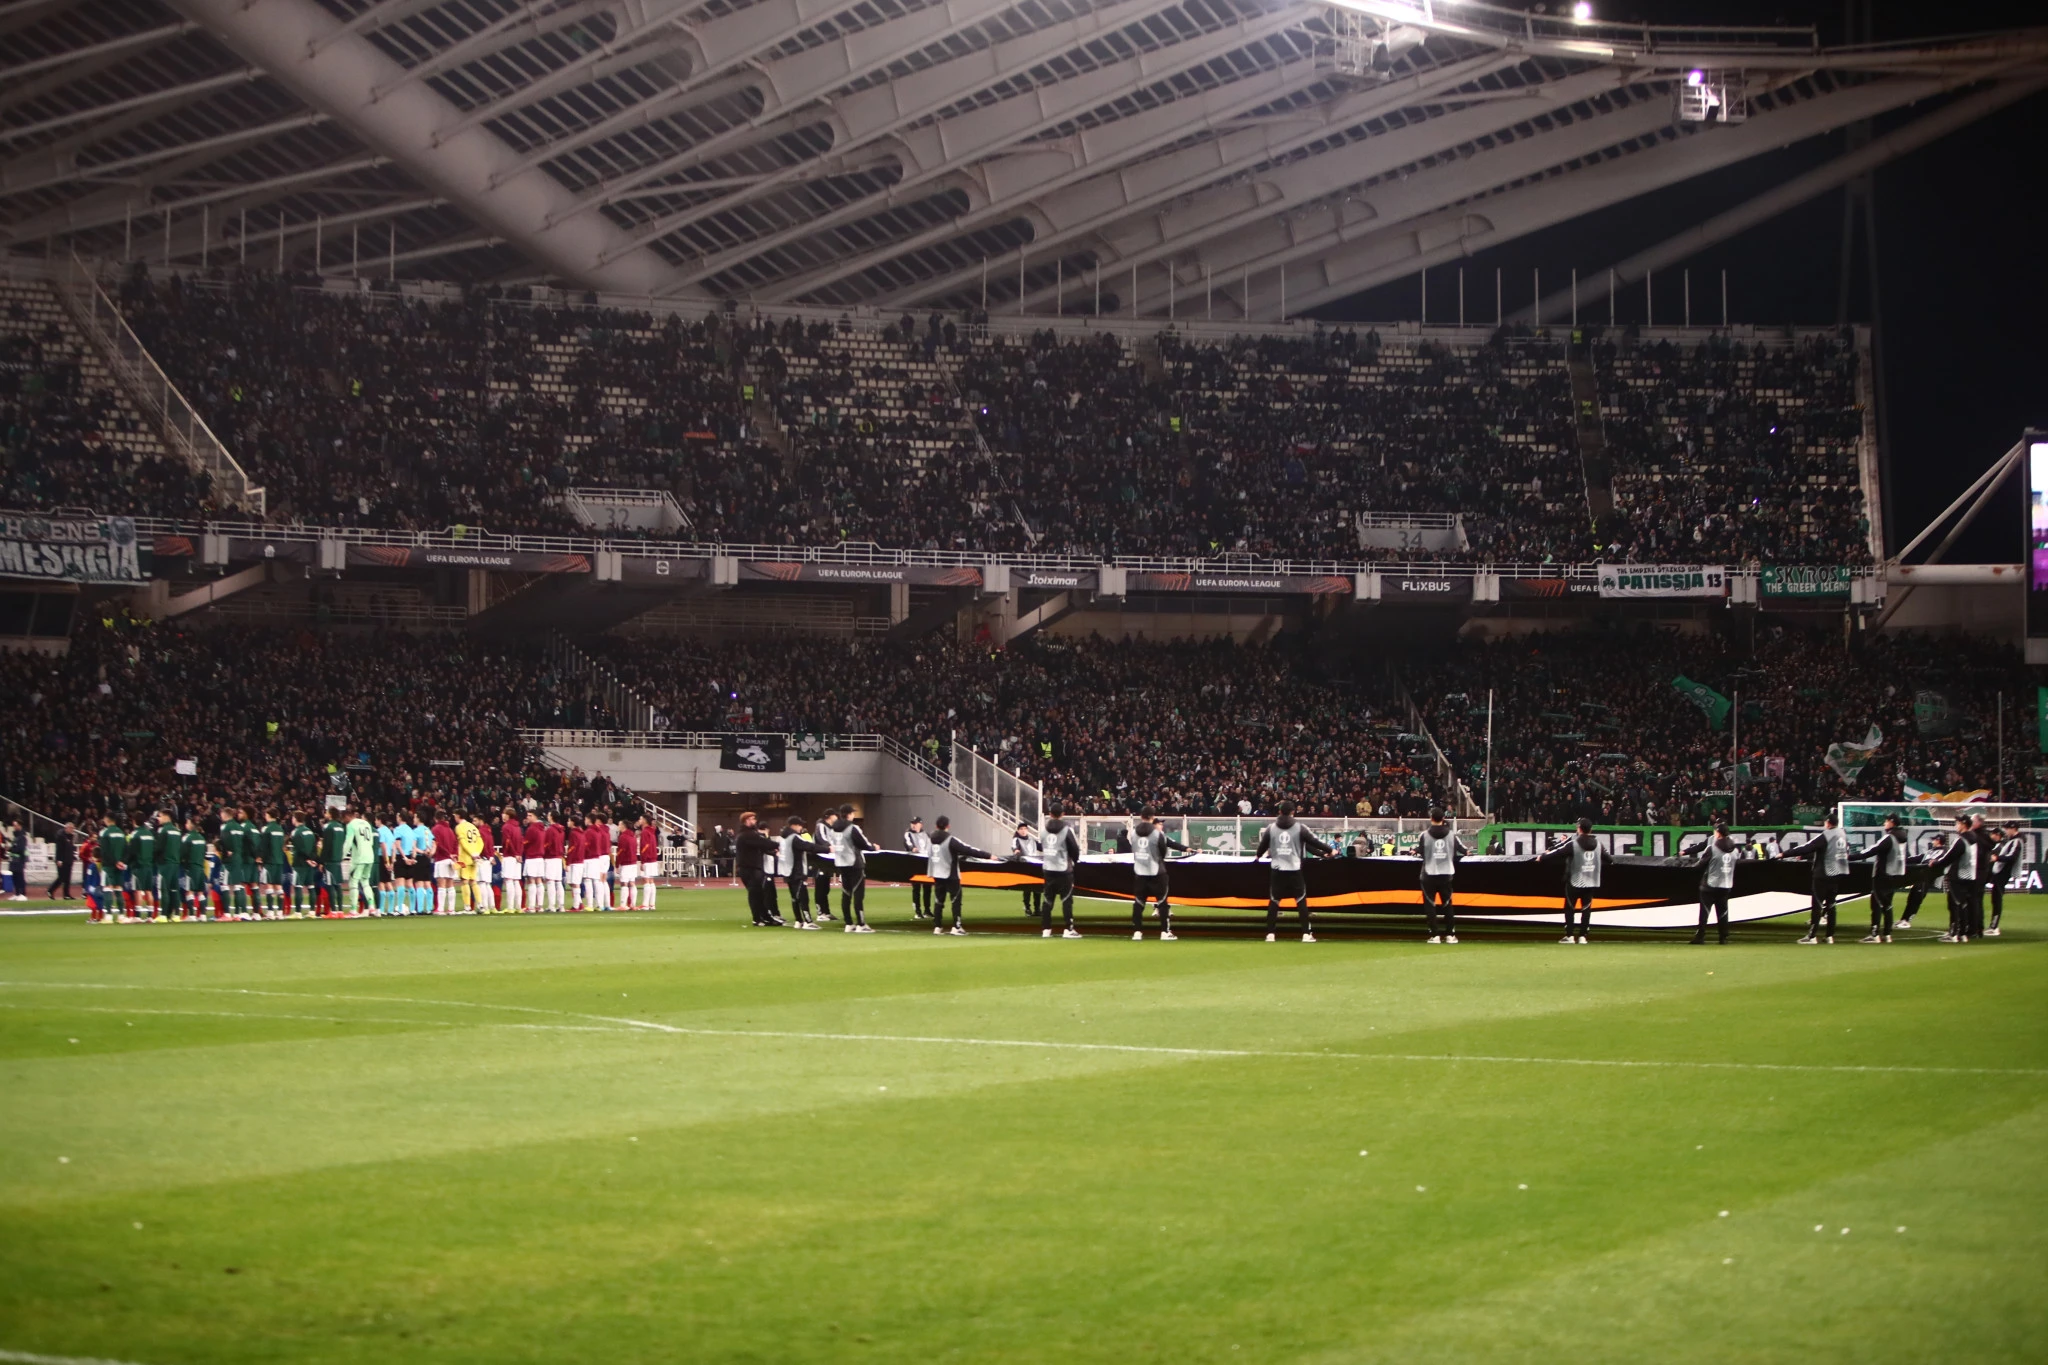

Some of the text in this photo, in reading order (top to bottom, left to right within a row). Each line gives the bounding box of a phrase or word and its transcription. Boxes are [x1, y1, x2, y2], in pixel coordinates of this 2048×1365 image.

[605, 507, 630, 528] 32
[1397, 530, 1423, 551] 34
[426, 554, 511, 565] UEFA EUROPA LEAGUE
[818, 569, 903, 579] UEFA EUROPA LEAGUE
[1027, 573, 1078, 586] Stoiximan
[1775, 565, 1838, 584] SKYROS
[1196, 578, 1281, 588] UEFA EUROPA LEAGUE
[1618, 573, 1722, 589] PATISSIA 13
[1766, 581, 1850, 593] THE GREEN ISLAND
[1570, 584, 1592, 592] UEFA
[359, 826, 370, 842] 40
[467, 829, 477, 843] 95
